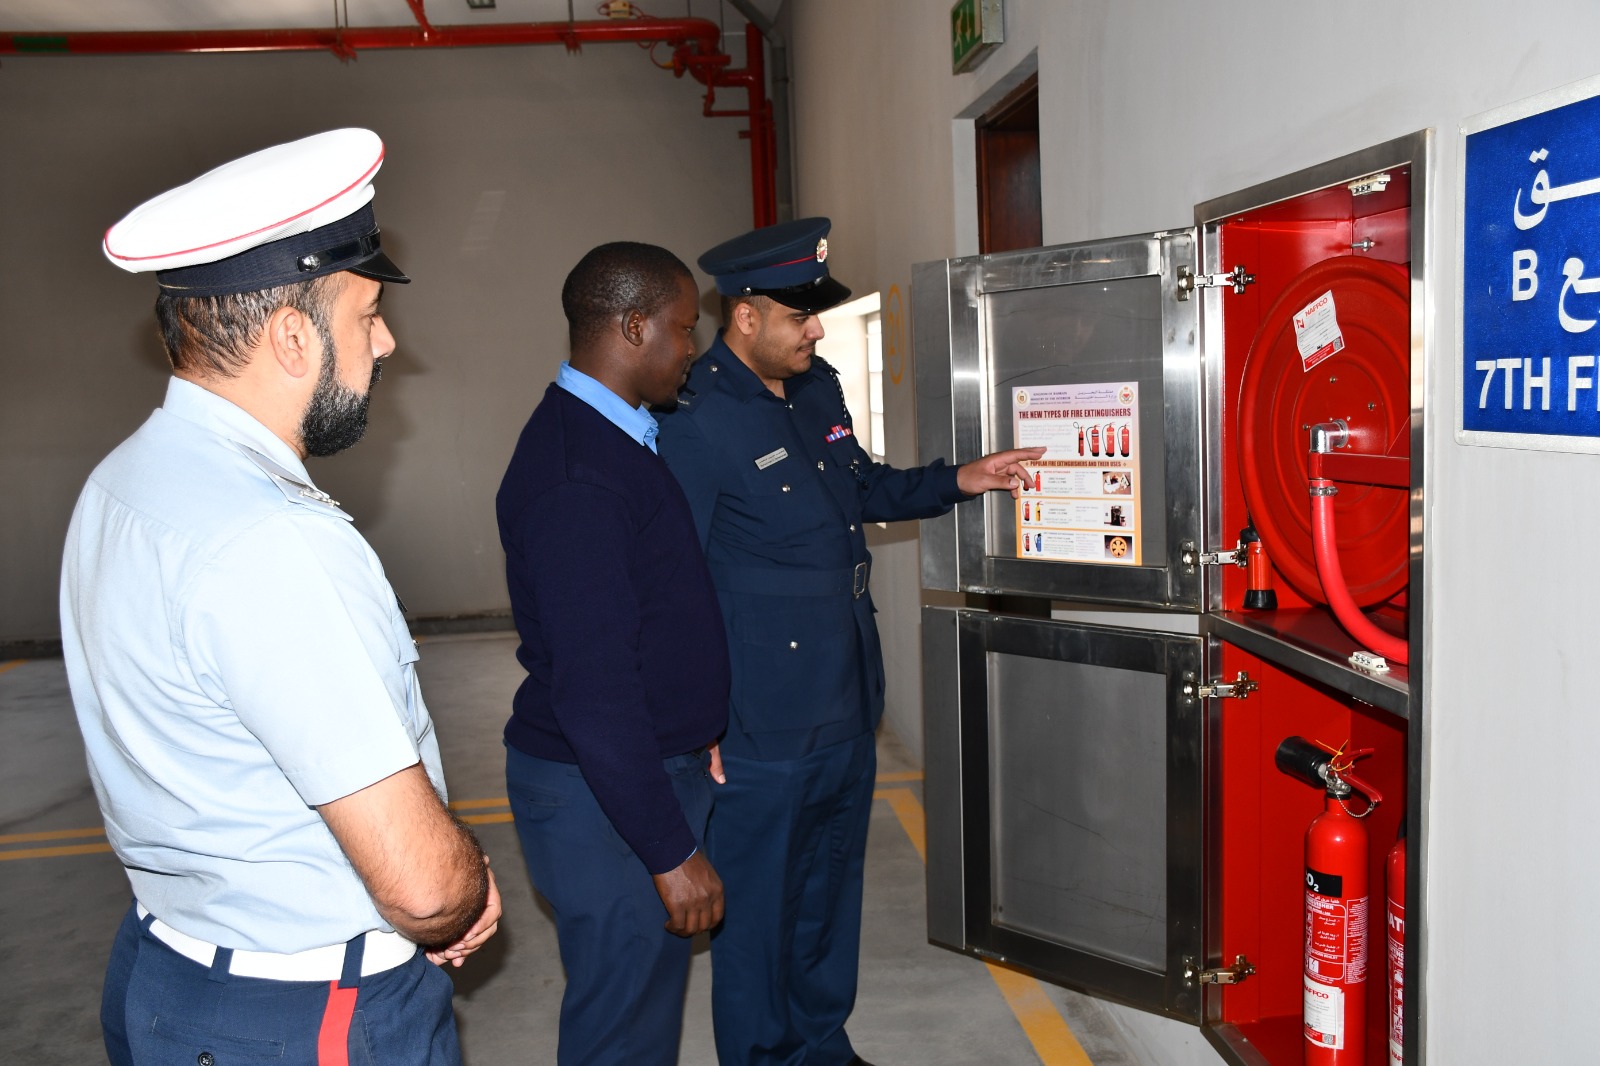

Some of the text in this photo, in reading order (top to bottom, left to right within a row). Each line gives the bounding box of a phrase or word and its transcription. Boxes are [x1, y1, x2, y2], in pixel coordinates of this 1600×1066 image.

[1513, 249, 1538, 301] B
[1305, 297, 1328, 317] NAFFCO
[1476, 355, 1600, 411] 7TH F
[1044, 410, 1061, 418] TYPES
[1071, 409, 1082, 417] FIRE
[1084, 408, 1131, 417] EXTINGUISHERS
[1306, 870, 1319, 892] O2
[1388, 908, 1404, 934] AT
